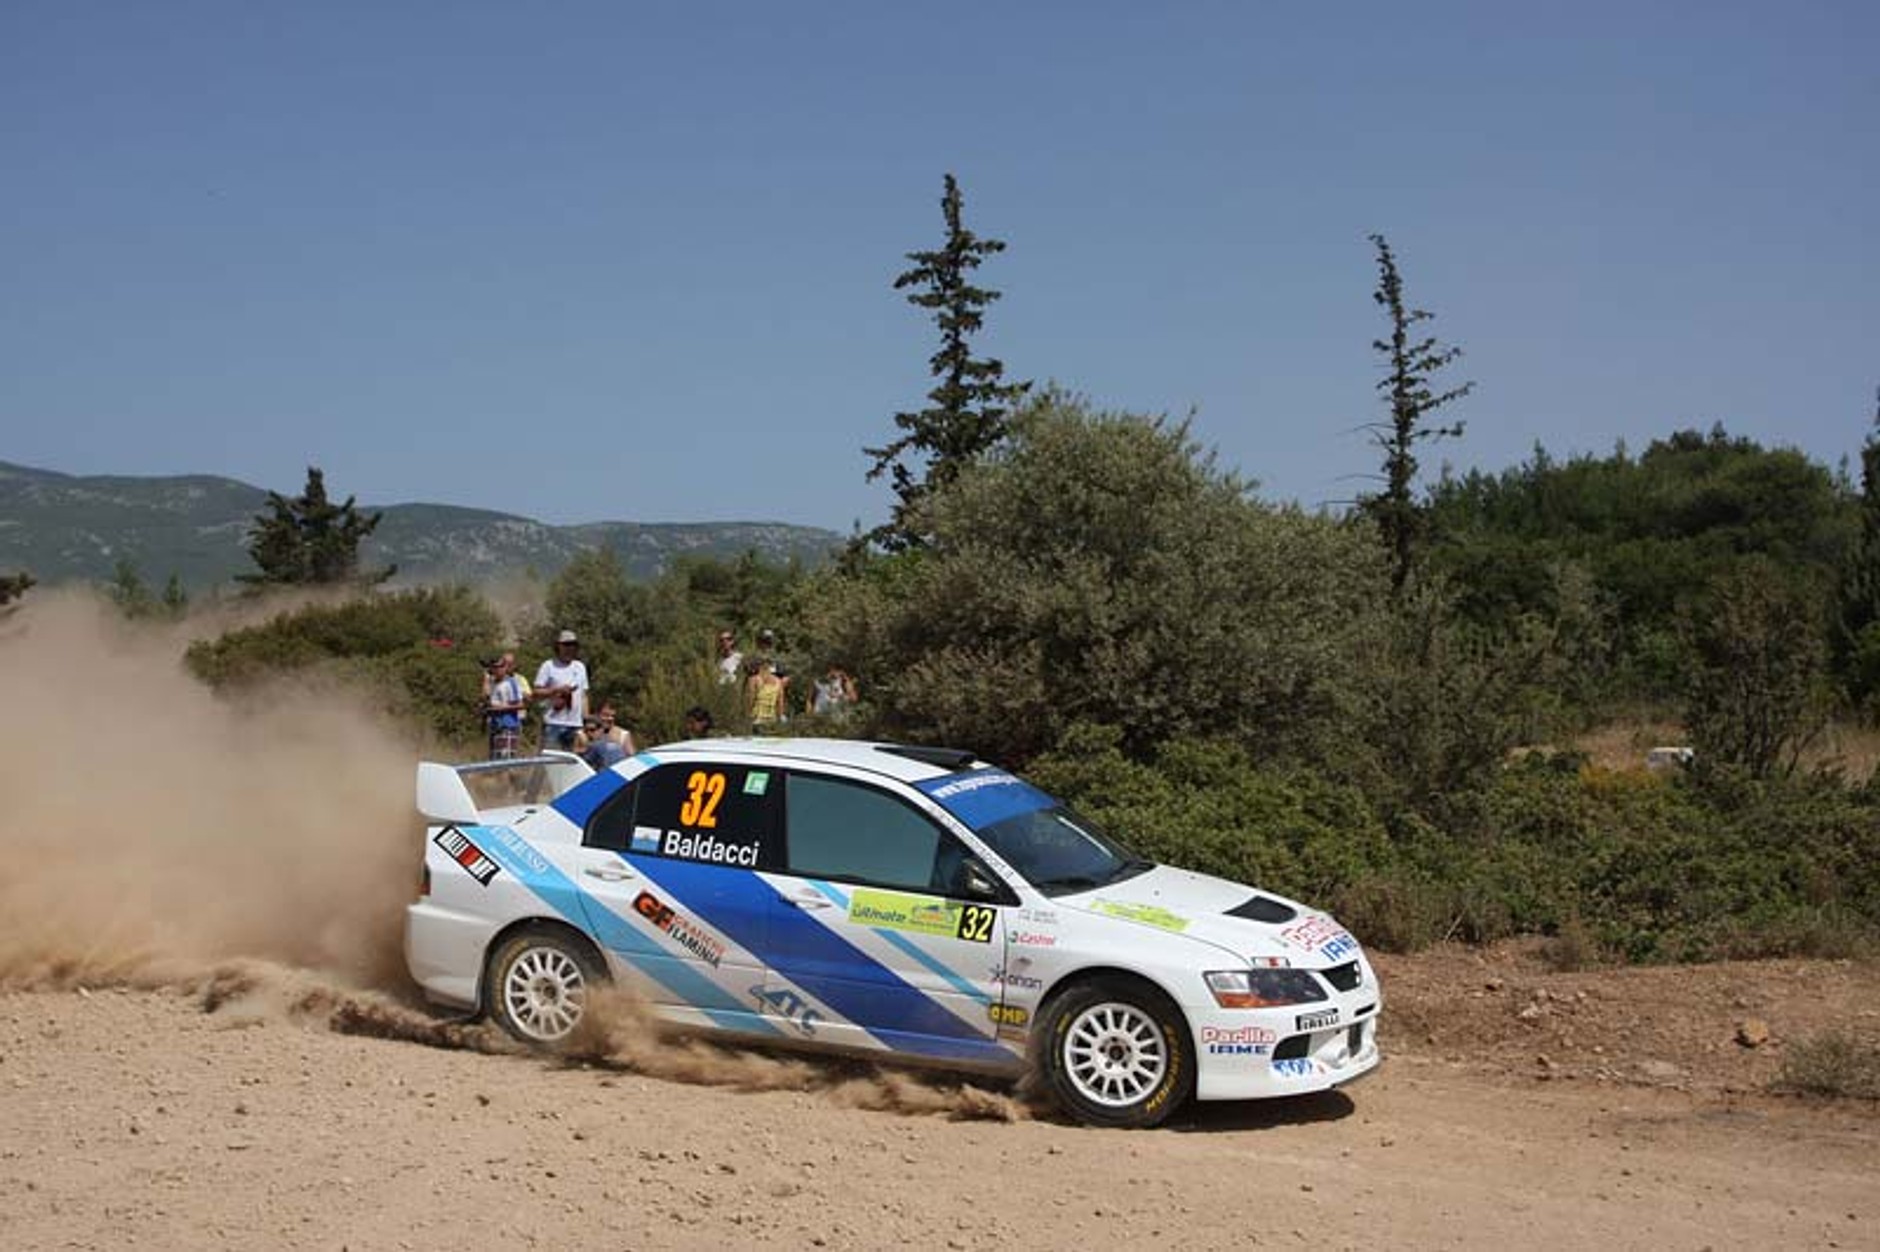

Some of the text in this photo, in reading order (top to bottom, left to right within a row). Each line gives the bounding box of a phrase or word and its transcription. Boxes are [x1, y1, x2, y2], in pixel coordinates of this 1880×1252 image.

[681, 771, 726, 828] 32
[664, 830, 760, 866] Baldacci
[962, 906, 993, 941] 32
[990, 1004, 1027, 1025] OMP
